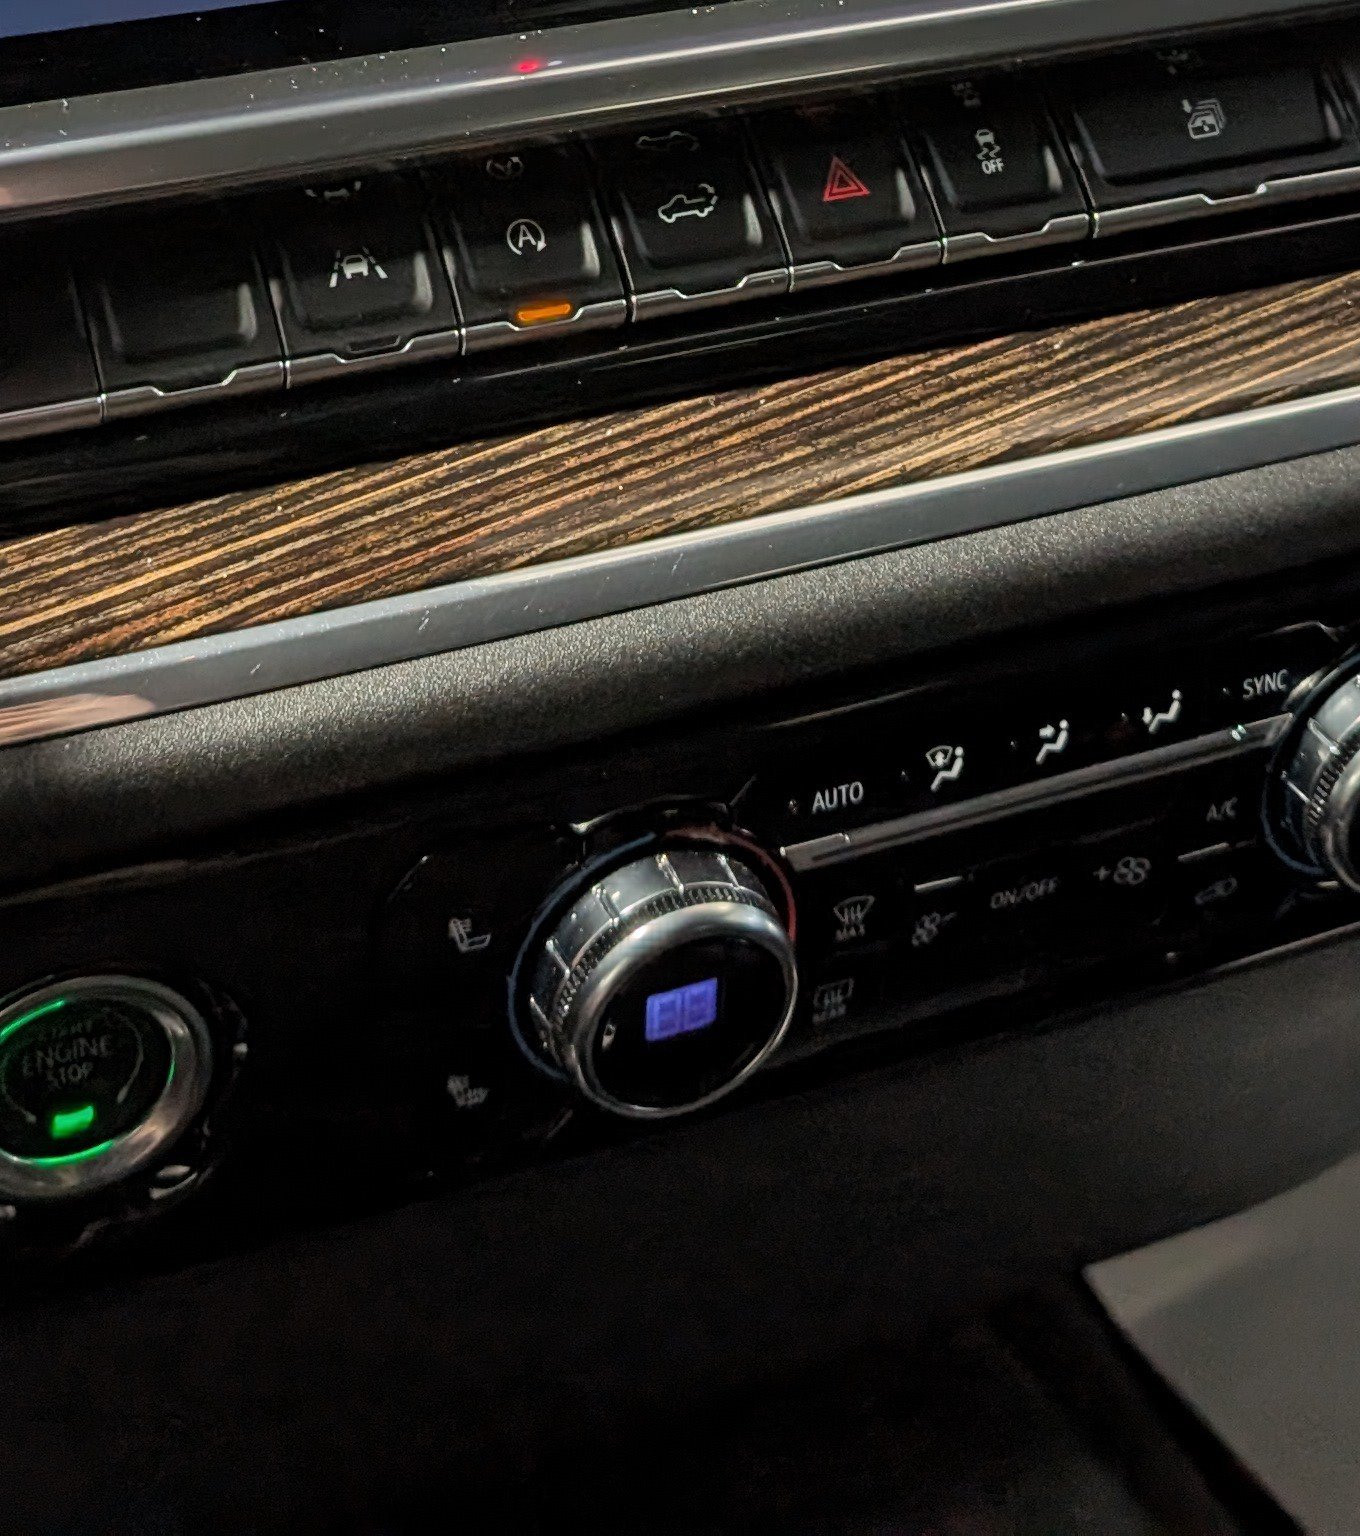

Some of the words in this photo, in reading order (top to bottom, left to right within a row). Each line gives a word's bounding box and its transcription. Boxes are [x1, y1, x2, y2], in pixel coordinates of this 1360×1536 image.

[981, 158, 1004, 175] OFF
[1242, 668, 1288, 700] SYNC
[812, 781, 864, 813] AUTO
